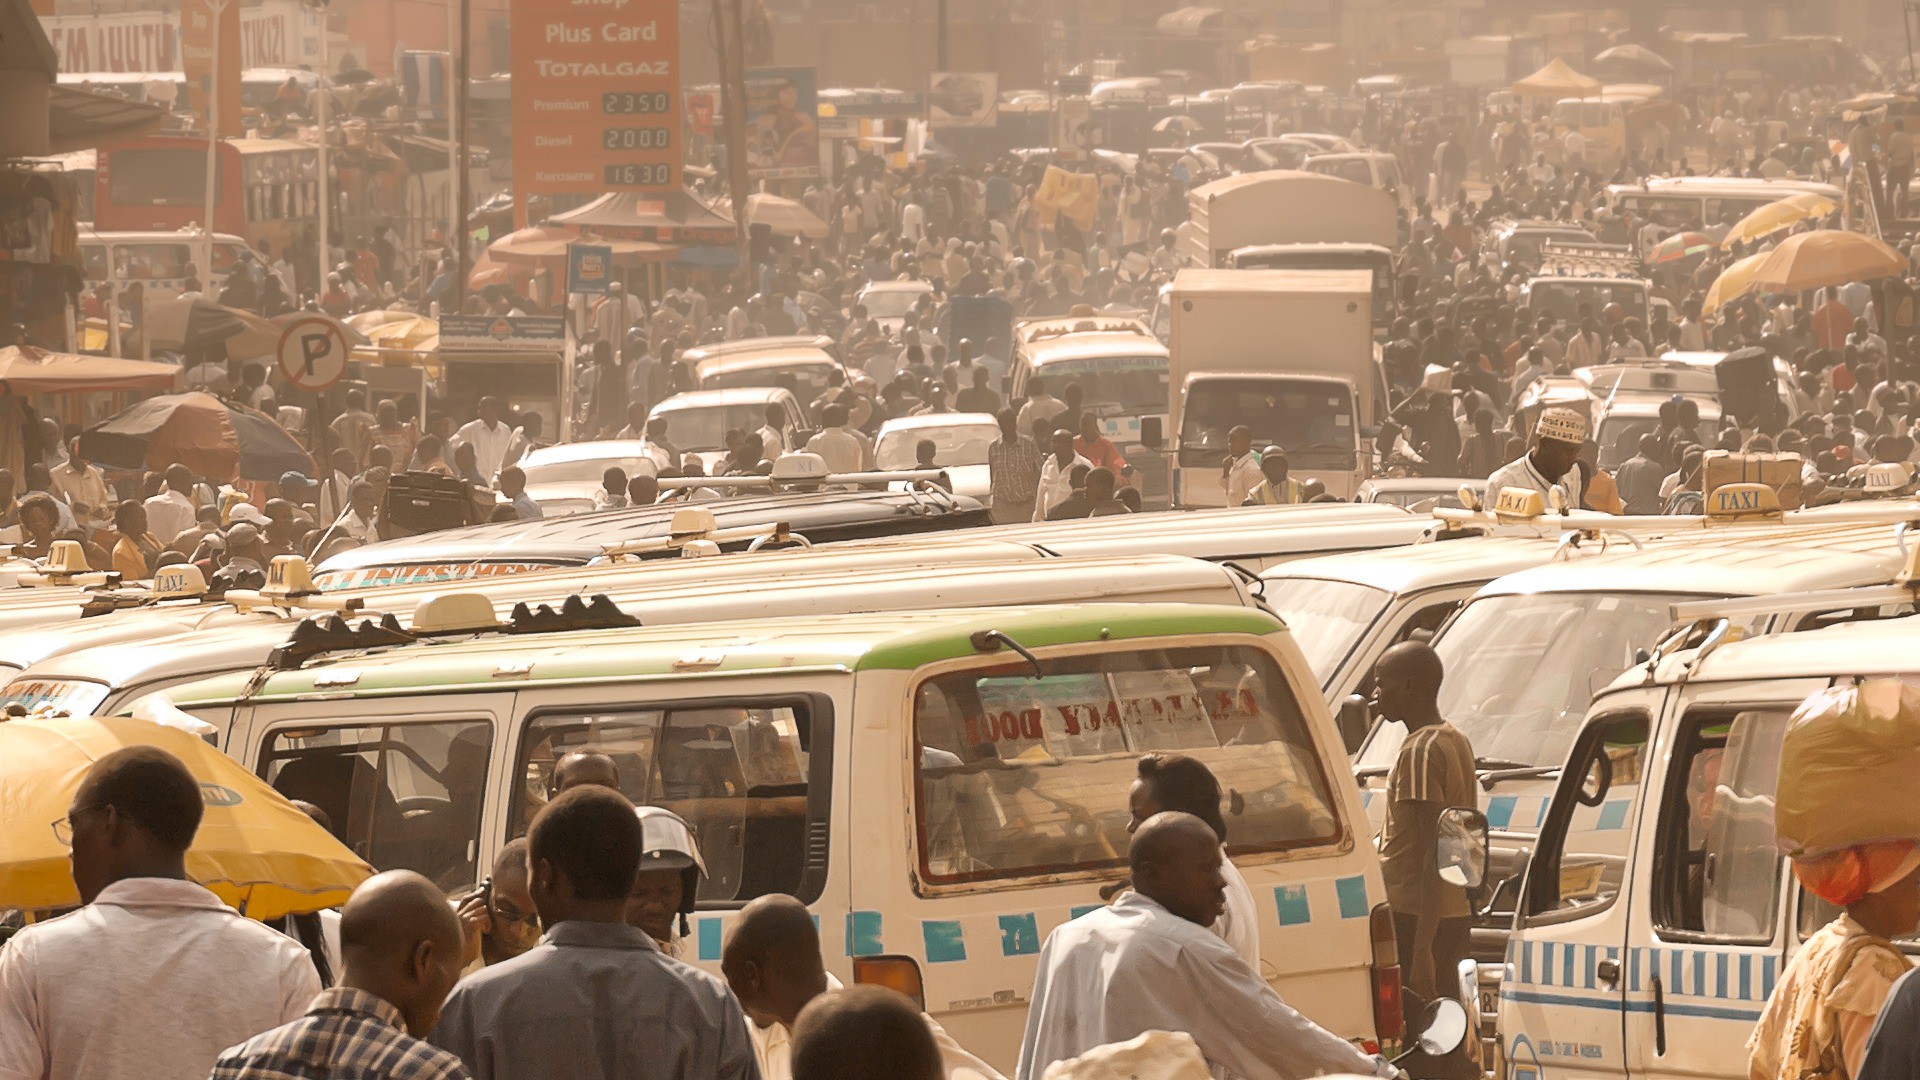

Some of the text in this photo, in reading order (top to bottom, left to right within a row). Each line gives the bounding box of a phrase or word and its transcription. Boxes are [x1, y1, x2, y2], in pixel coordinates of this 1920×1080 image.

[546, 21, 657, 43] Plus Card
[534, 59, 670, 78] TOTALGAZ
[534, 94, 666, 112] Premium 2350
[535, 130, 667, 148] Diesel 2000
[535, 165, 668, 184] Kerosene 1630
[301, 333, 331, 376] P
[1500, 493, 1528, 512] TAXI
[1717, 490, 1758, 510] TAXI
